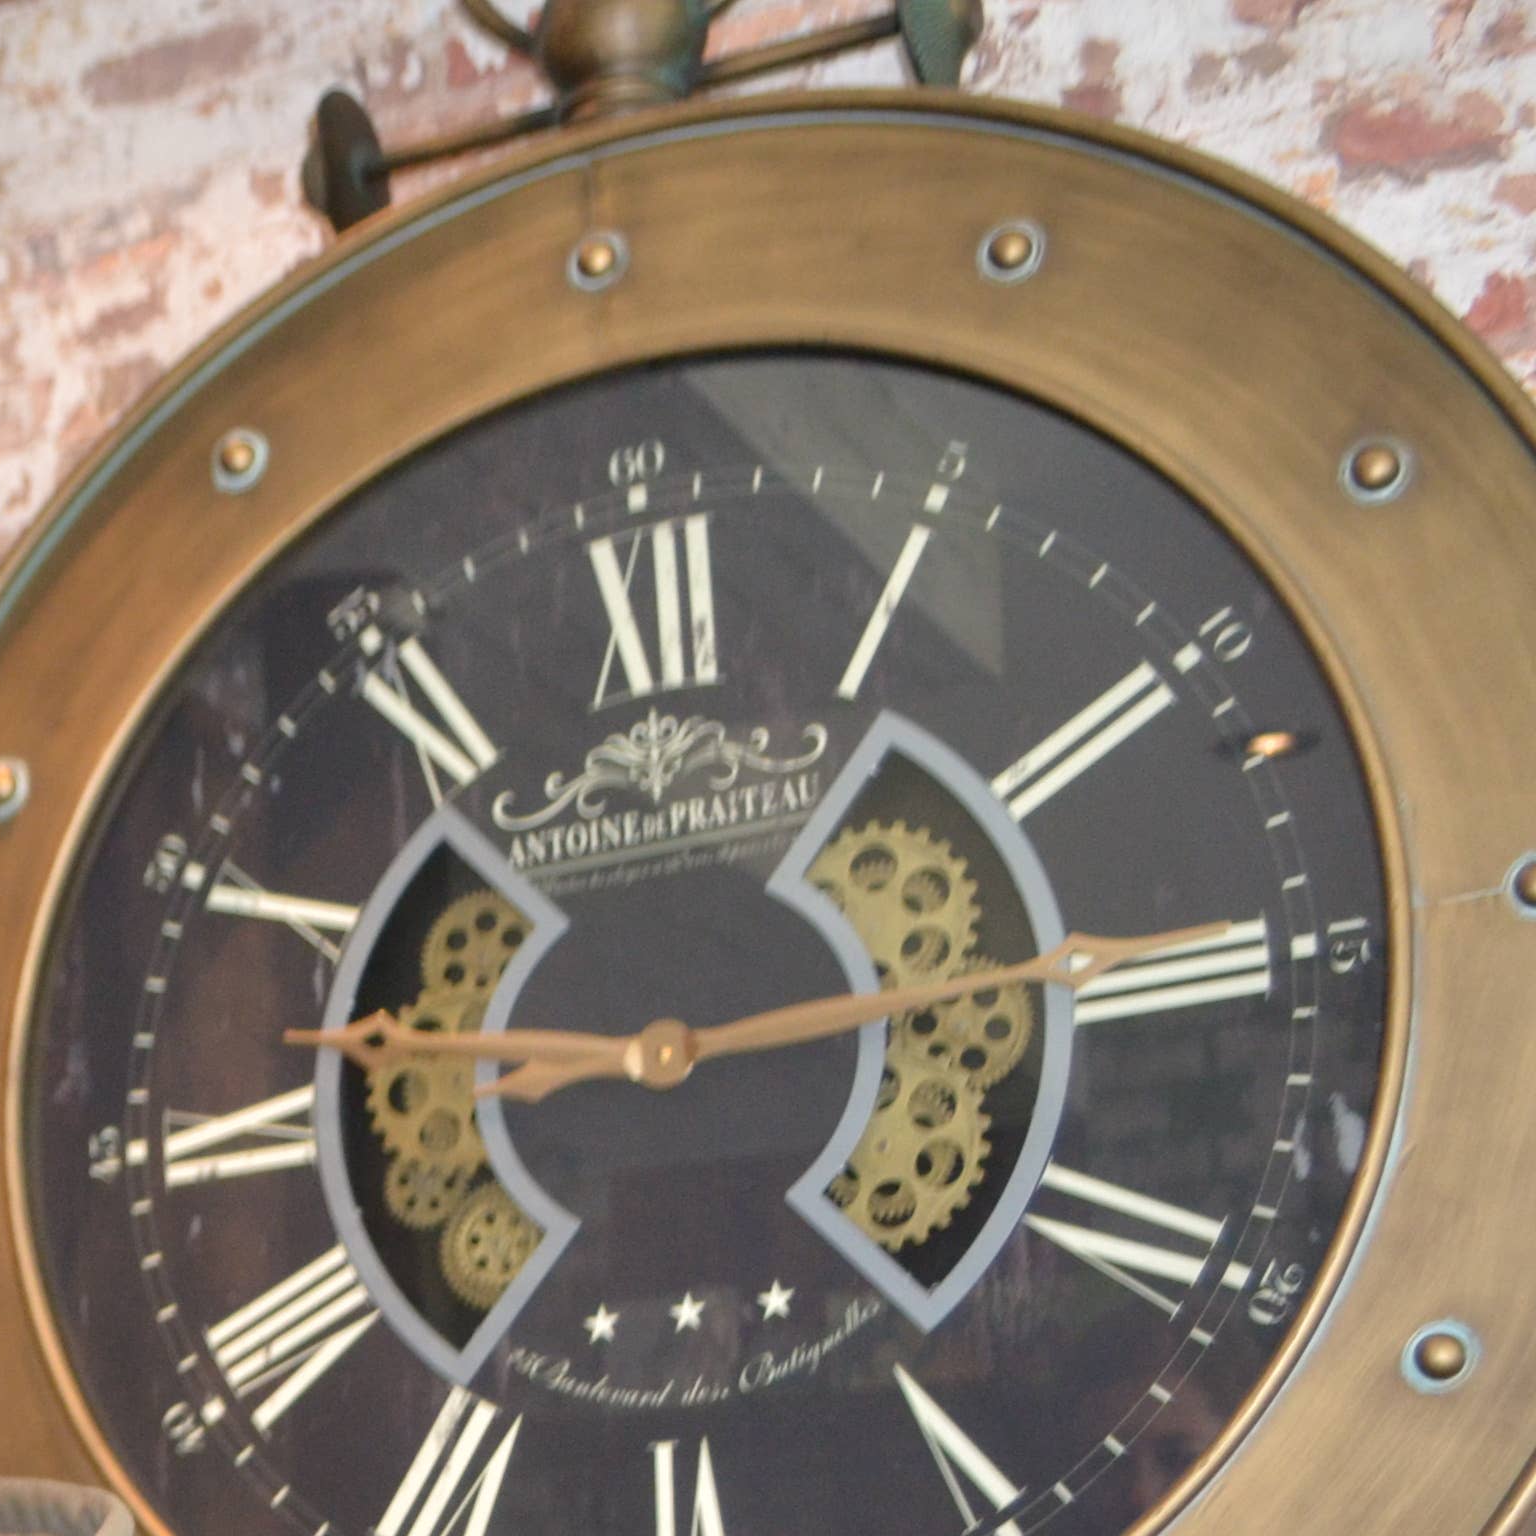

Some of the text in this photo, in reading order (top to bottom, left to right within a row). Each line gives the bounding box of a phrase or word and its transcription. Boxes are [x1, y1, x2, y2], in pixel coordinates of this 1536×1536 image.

[608, 439, 666, 487] 60
[588, 510, 727, 714] XII
[1198, 605, 1253, 663] 10
[988, 658, 1178, 823] II
[509, 809, 641, 871] ANTOINE
[1327, 915, 1372, 976] 15
[162, 1082, 319, 1192] IX
[1023, 1153, 1230, 1324] IV
[203, 1241, 384, 1441] VIII
